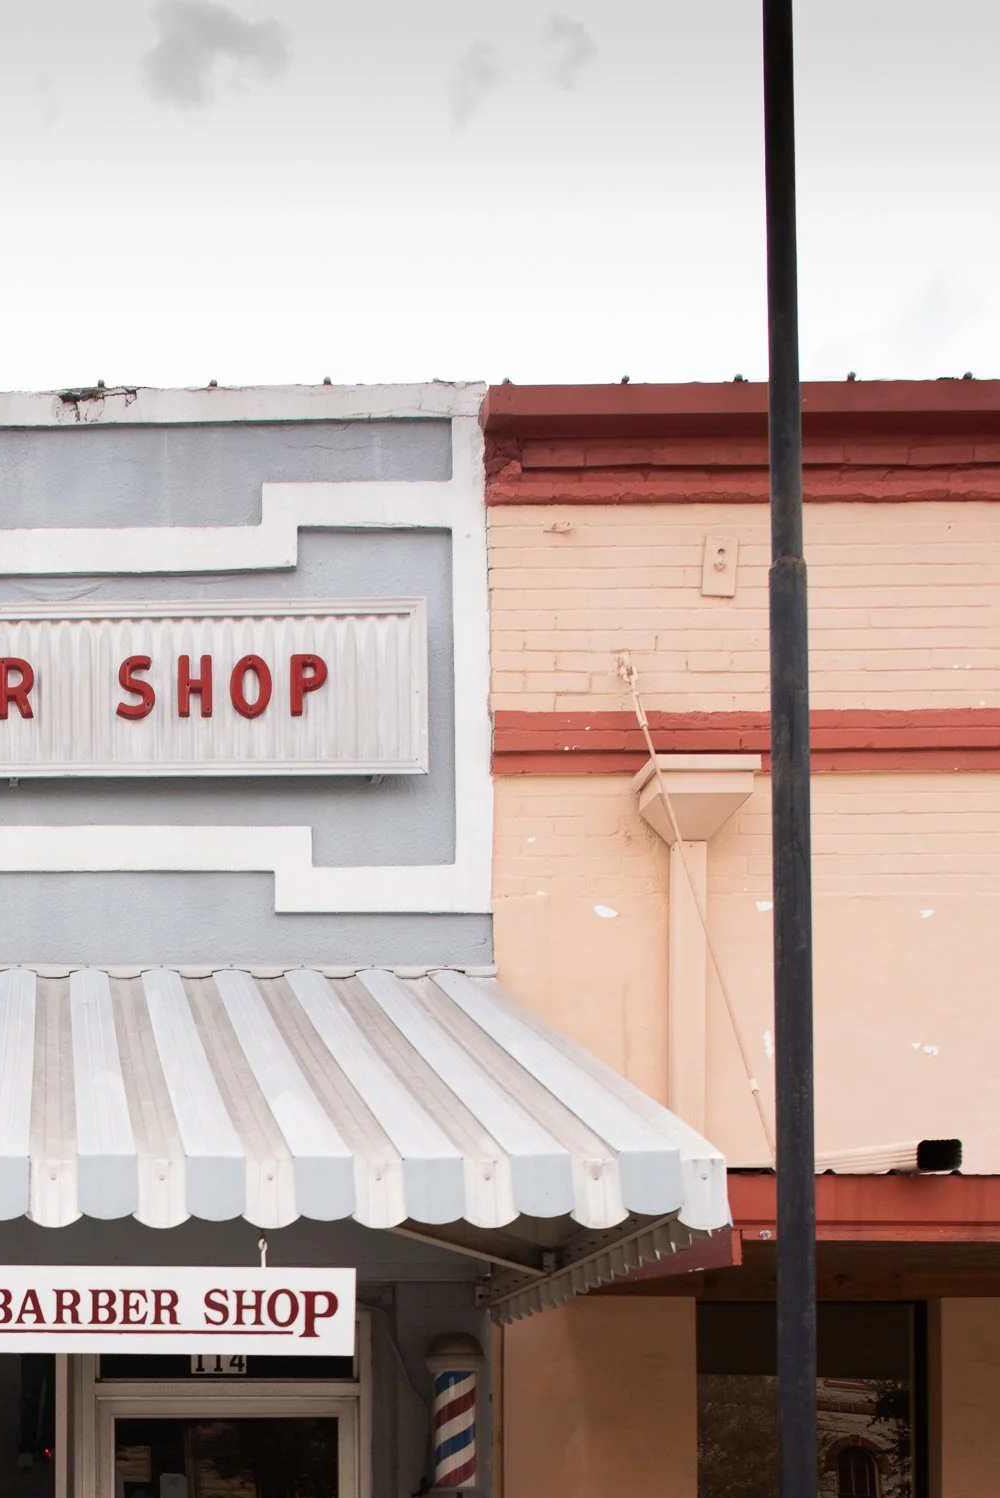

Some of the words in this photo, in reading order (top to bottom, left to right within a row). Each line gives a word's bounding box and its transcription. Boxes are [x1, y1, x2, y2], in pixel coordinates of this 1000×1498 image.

[115, 653, 329, 721] SHOP
[203, 1288, 339, 1338] SHOP
[194, 1354, 245, 1373] 114
